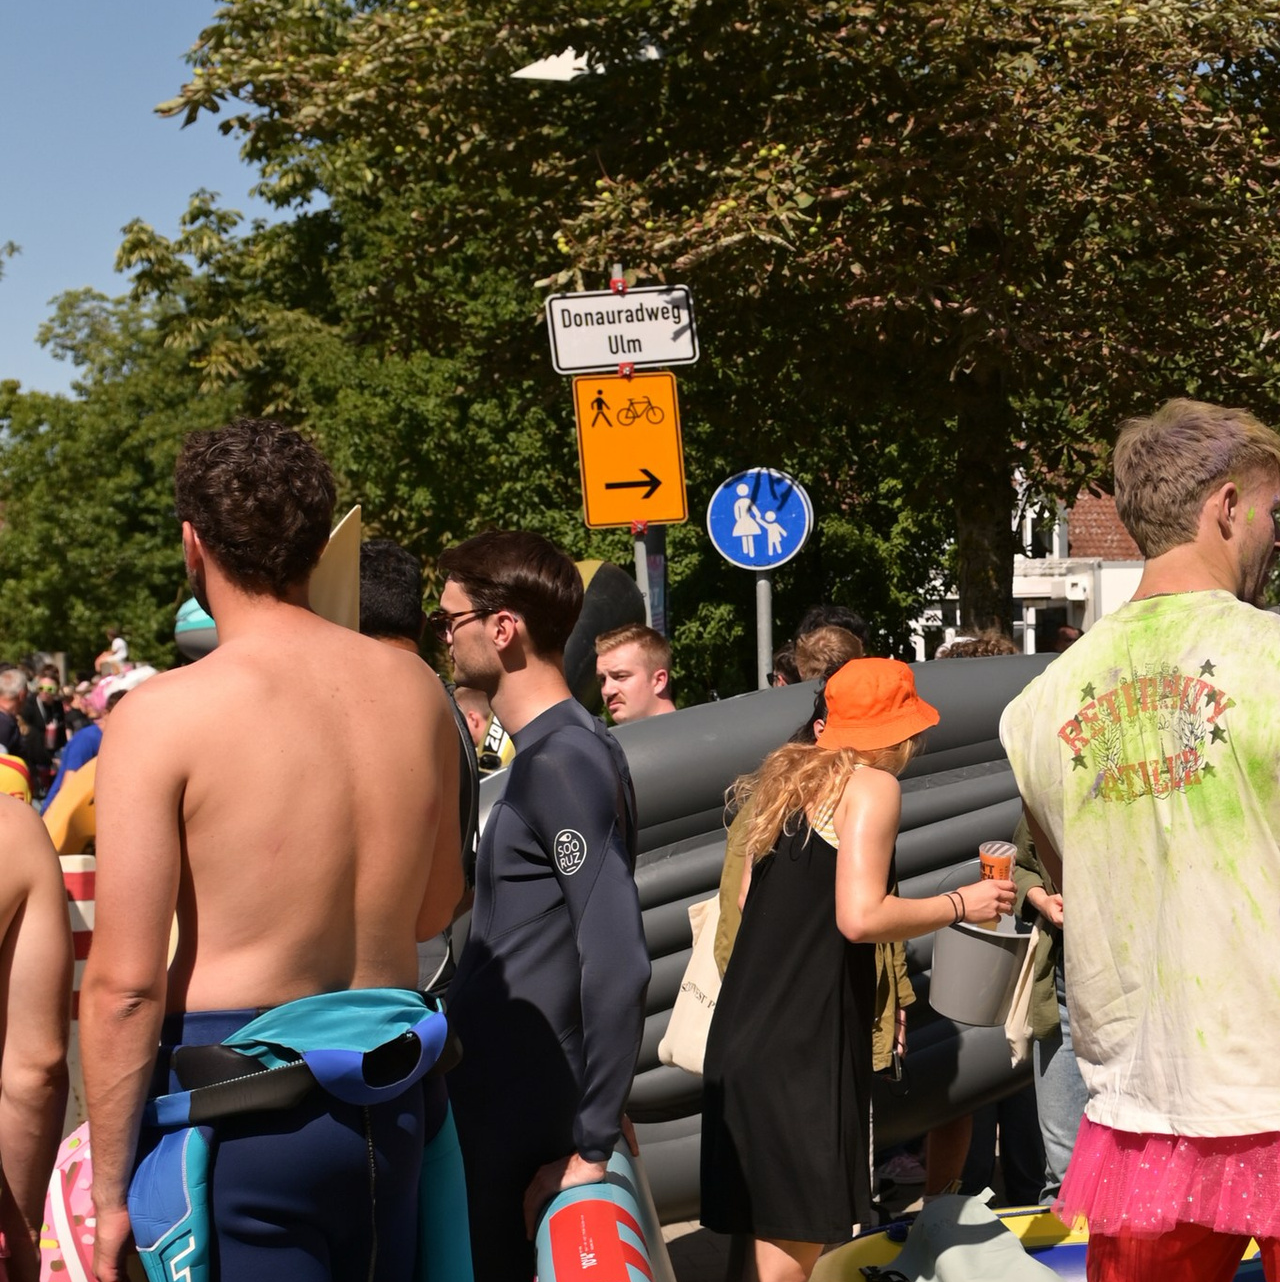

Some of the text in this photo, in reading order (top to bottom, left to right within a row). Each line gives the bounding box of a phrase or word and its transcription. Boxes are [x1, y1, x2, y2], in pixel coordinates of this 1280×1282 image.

[561, 303, 682, 328] Donauradweg
[608, 334, 643, 355] Ulm
[560, 852, 582, 869] RUZ
